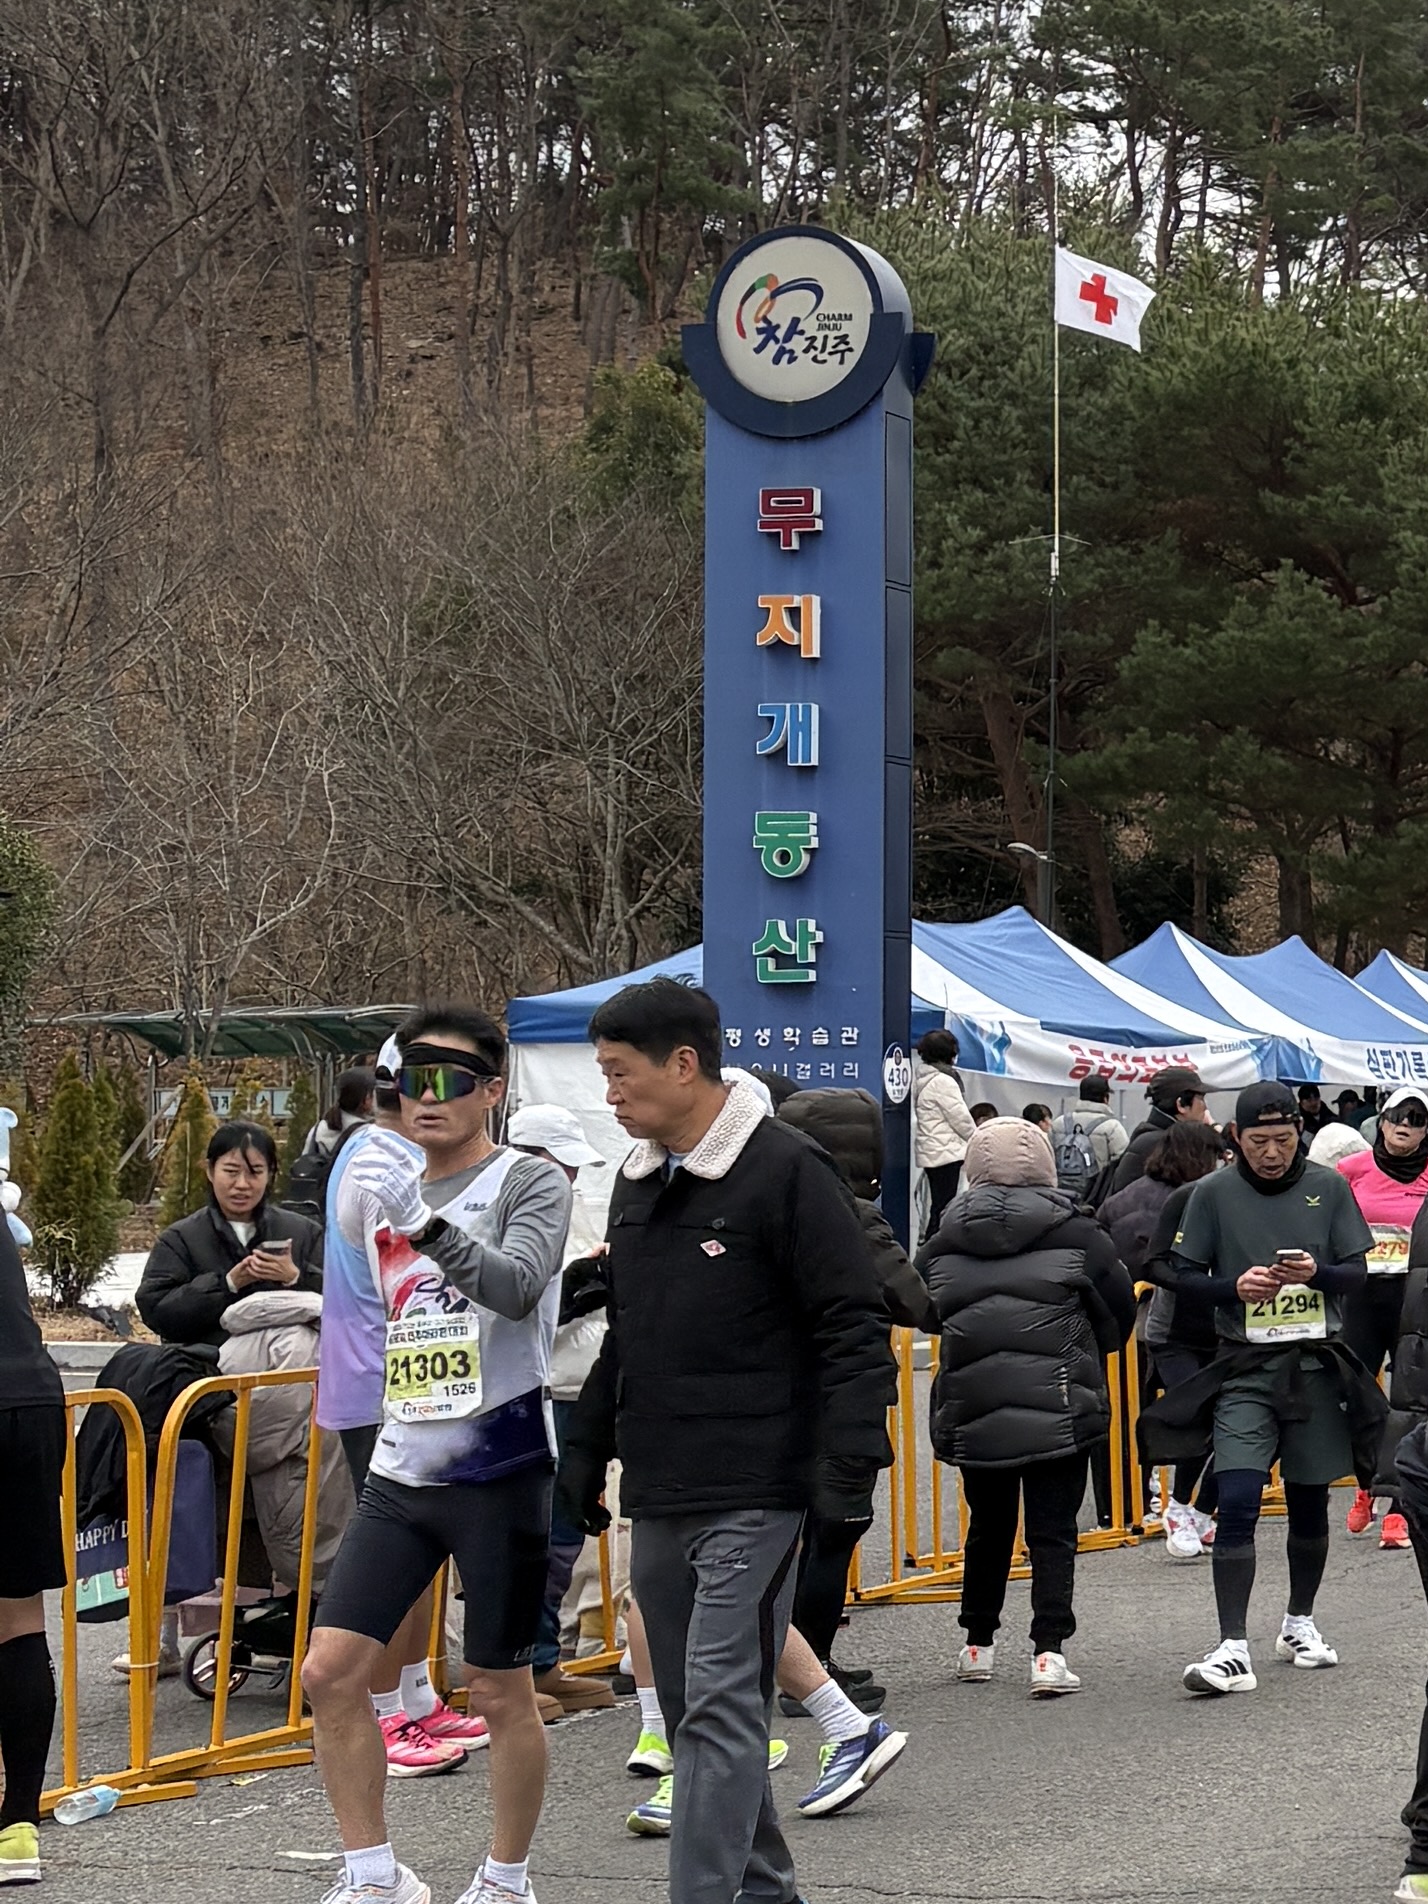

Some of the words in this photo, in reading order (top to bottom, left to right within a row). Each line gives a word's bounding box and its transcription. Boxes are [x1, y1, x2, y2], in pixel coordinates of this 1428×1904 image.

[816, 313, 853, 322] CHARM
[888, 1067, 908, 1086] 430
[1252, 1293, 1320, 1317] 21294
[390, 1350, 471, 1386] 21303
[75, 1519, 120, 1552] HAPPY
